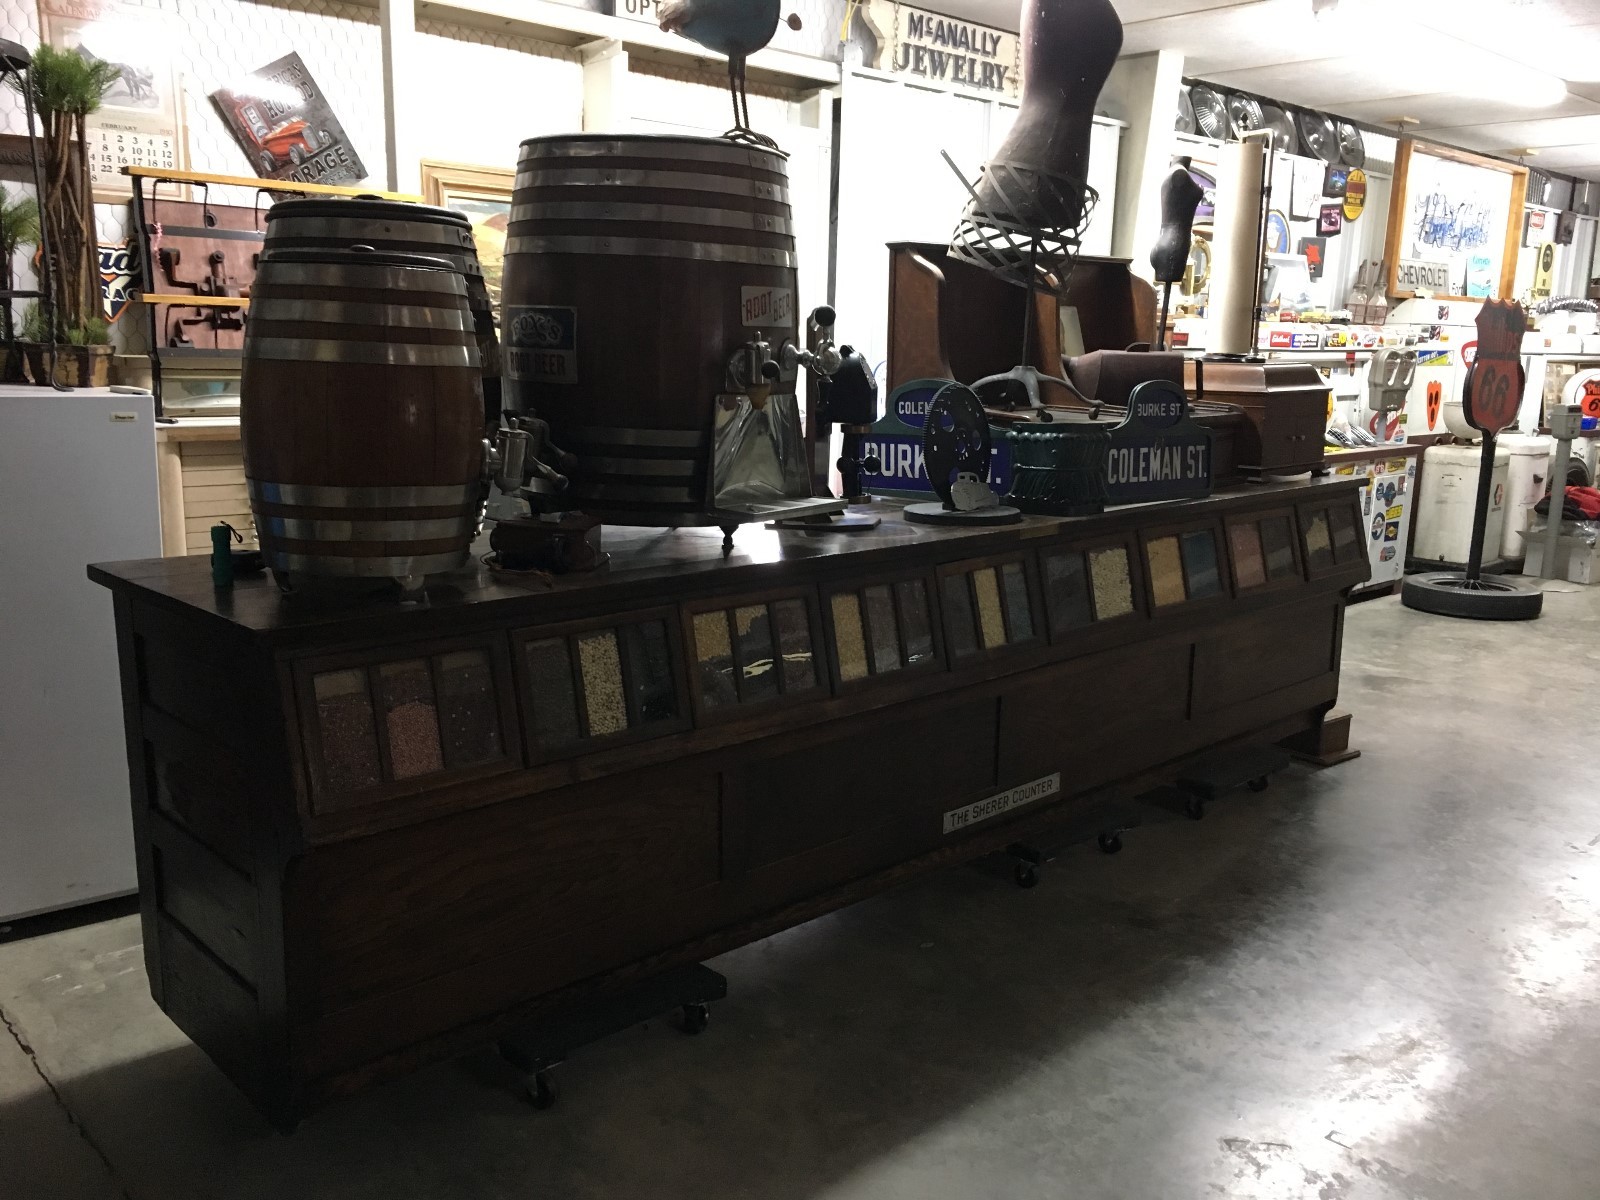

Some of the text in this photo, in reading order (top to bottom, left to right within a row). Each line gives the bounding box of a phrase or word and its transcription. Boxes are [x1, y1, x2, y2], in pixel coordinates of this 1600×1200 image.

[894, 41, 1009, 92] JEWELRY
[101, 122, 137, 132] FEBRUARY
[102, 133, 169, 148] 1 2 3 4 5
[102, 143, 108, 151] 8
[118, 145, 124, 153] 9
[132, 147, 142, 155] 10
[147, 149, 156, 157] 11
[162, 150, 172, 158] 12
[101, 154, 112, 162] 15
[117, 156, 128, 164] 16
[132, 158, 142, 166] 17
[147, 159, 158, 167] 18
[101, 165, 112, 173] 22
[1397, 263, 1448, 287] CHEVROLET
[745, 291, 791, 322] ROOT BEER
[533, 353, 567, 377] BEER
[1480, 365, 1510, 419] 66
[1137, 403, 1182, 417] BURKE ST.
[864, 442, 930, 480] BURK
[1107, 445, 1207, 485] COLEMAN ST.
[950, 779, 1053, 827] THE SHERER COUNTER
